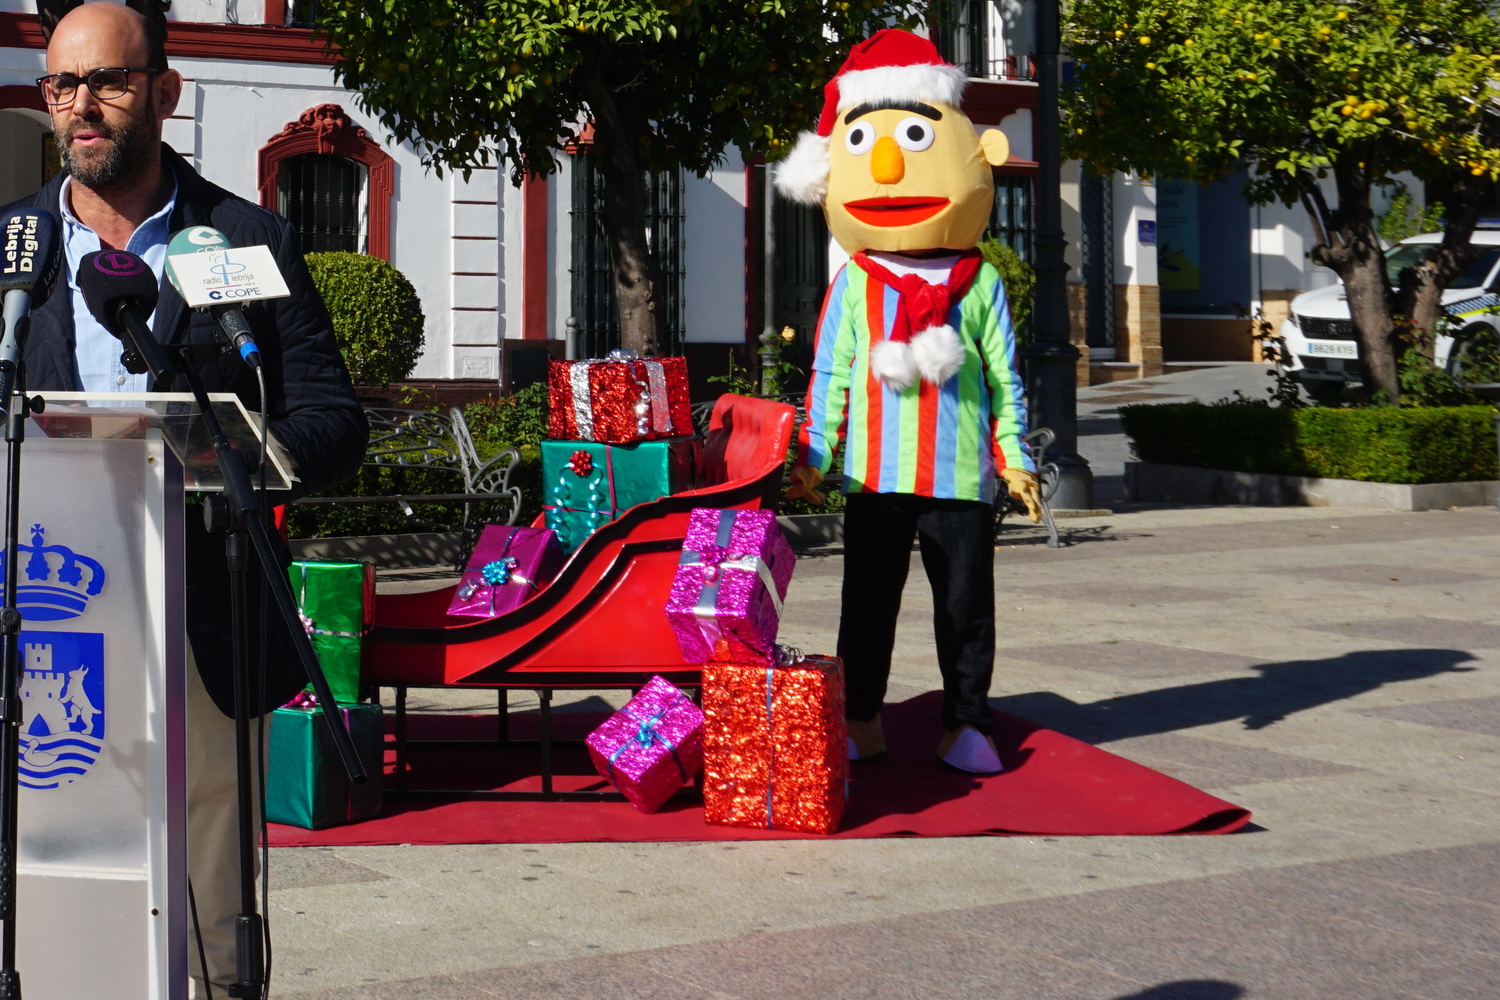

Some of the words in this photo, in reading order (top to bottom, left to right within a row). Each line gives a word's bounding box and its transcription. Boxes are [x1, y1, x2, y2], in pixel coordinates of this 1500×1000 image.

[4, 215, 23, 274] Lebrija
[19, 215, 38, 273] Digital
[203, 276, 222, 285] radio
[231, 273, 254, 283] lebrija
[225, 287, 262, 298] COPE
